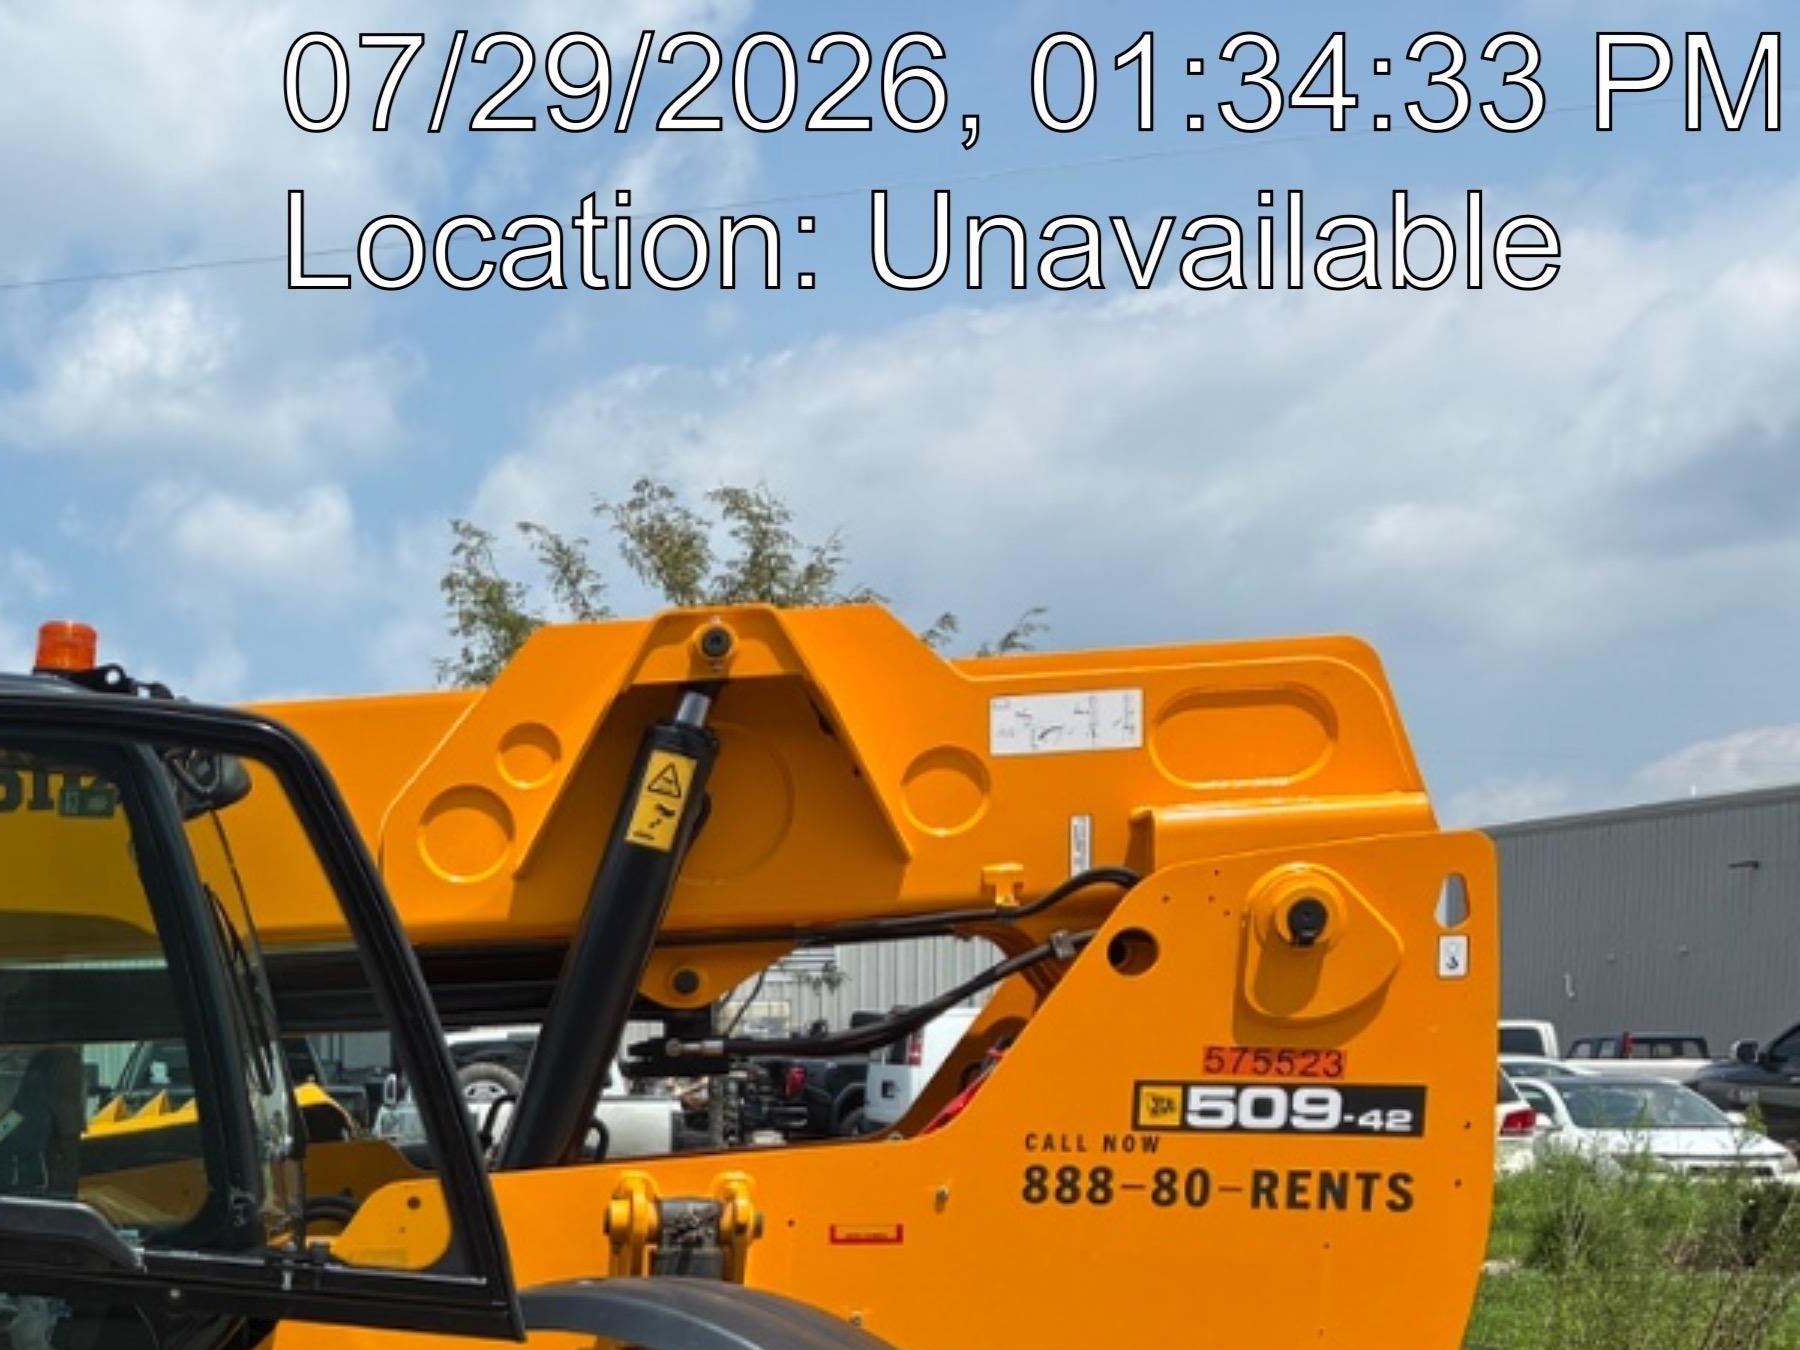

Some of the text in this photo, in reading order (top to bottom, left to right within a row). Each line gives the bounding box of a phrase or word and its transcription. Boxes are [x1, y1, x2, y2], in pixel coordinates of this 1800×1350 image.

[1204, 1046, 1344, 1078] 575523
[1186, 1086, 1413, 1132] 509-42
[1025, 1133, 1161, 1154] CALL NOW
[1022, 1164, 1415, 1213] 888-80-RENTS
